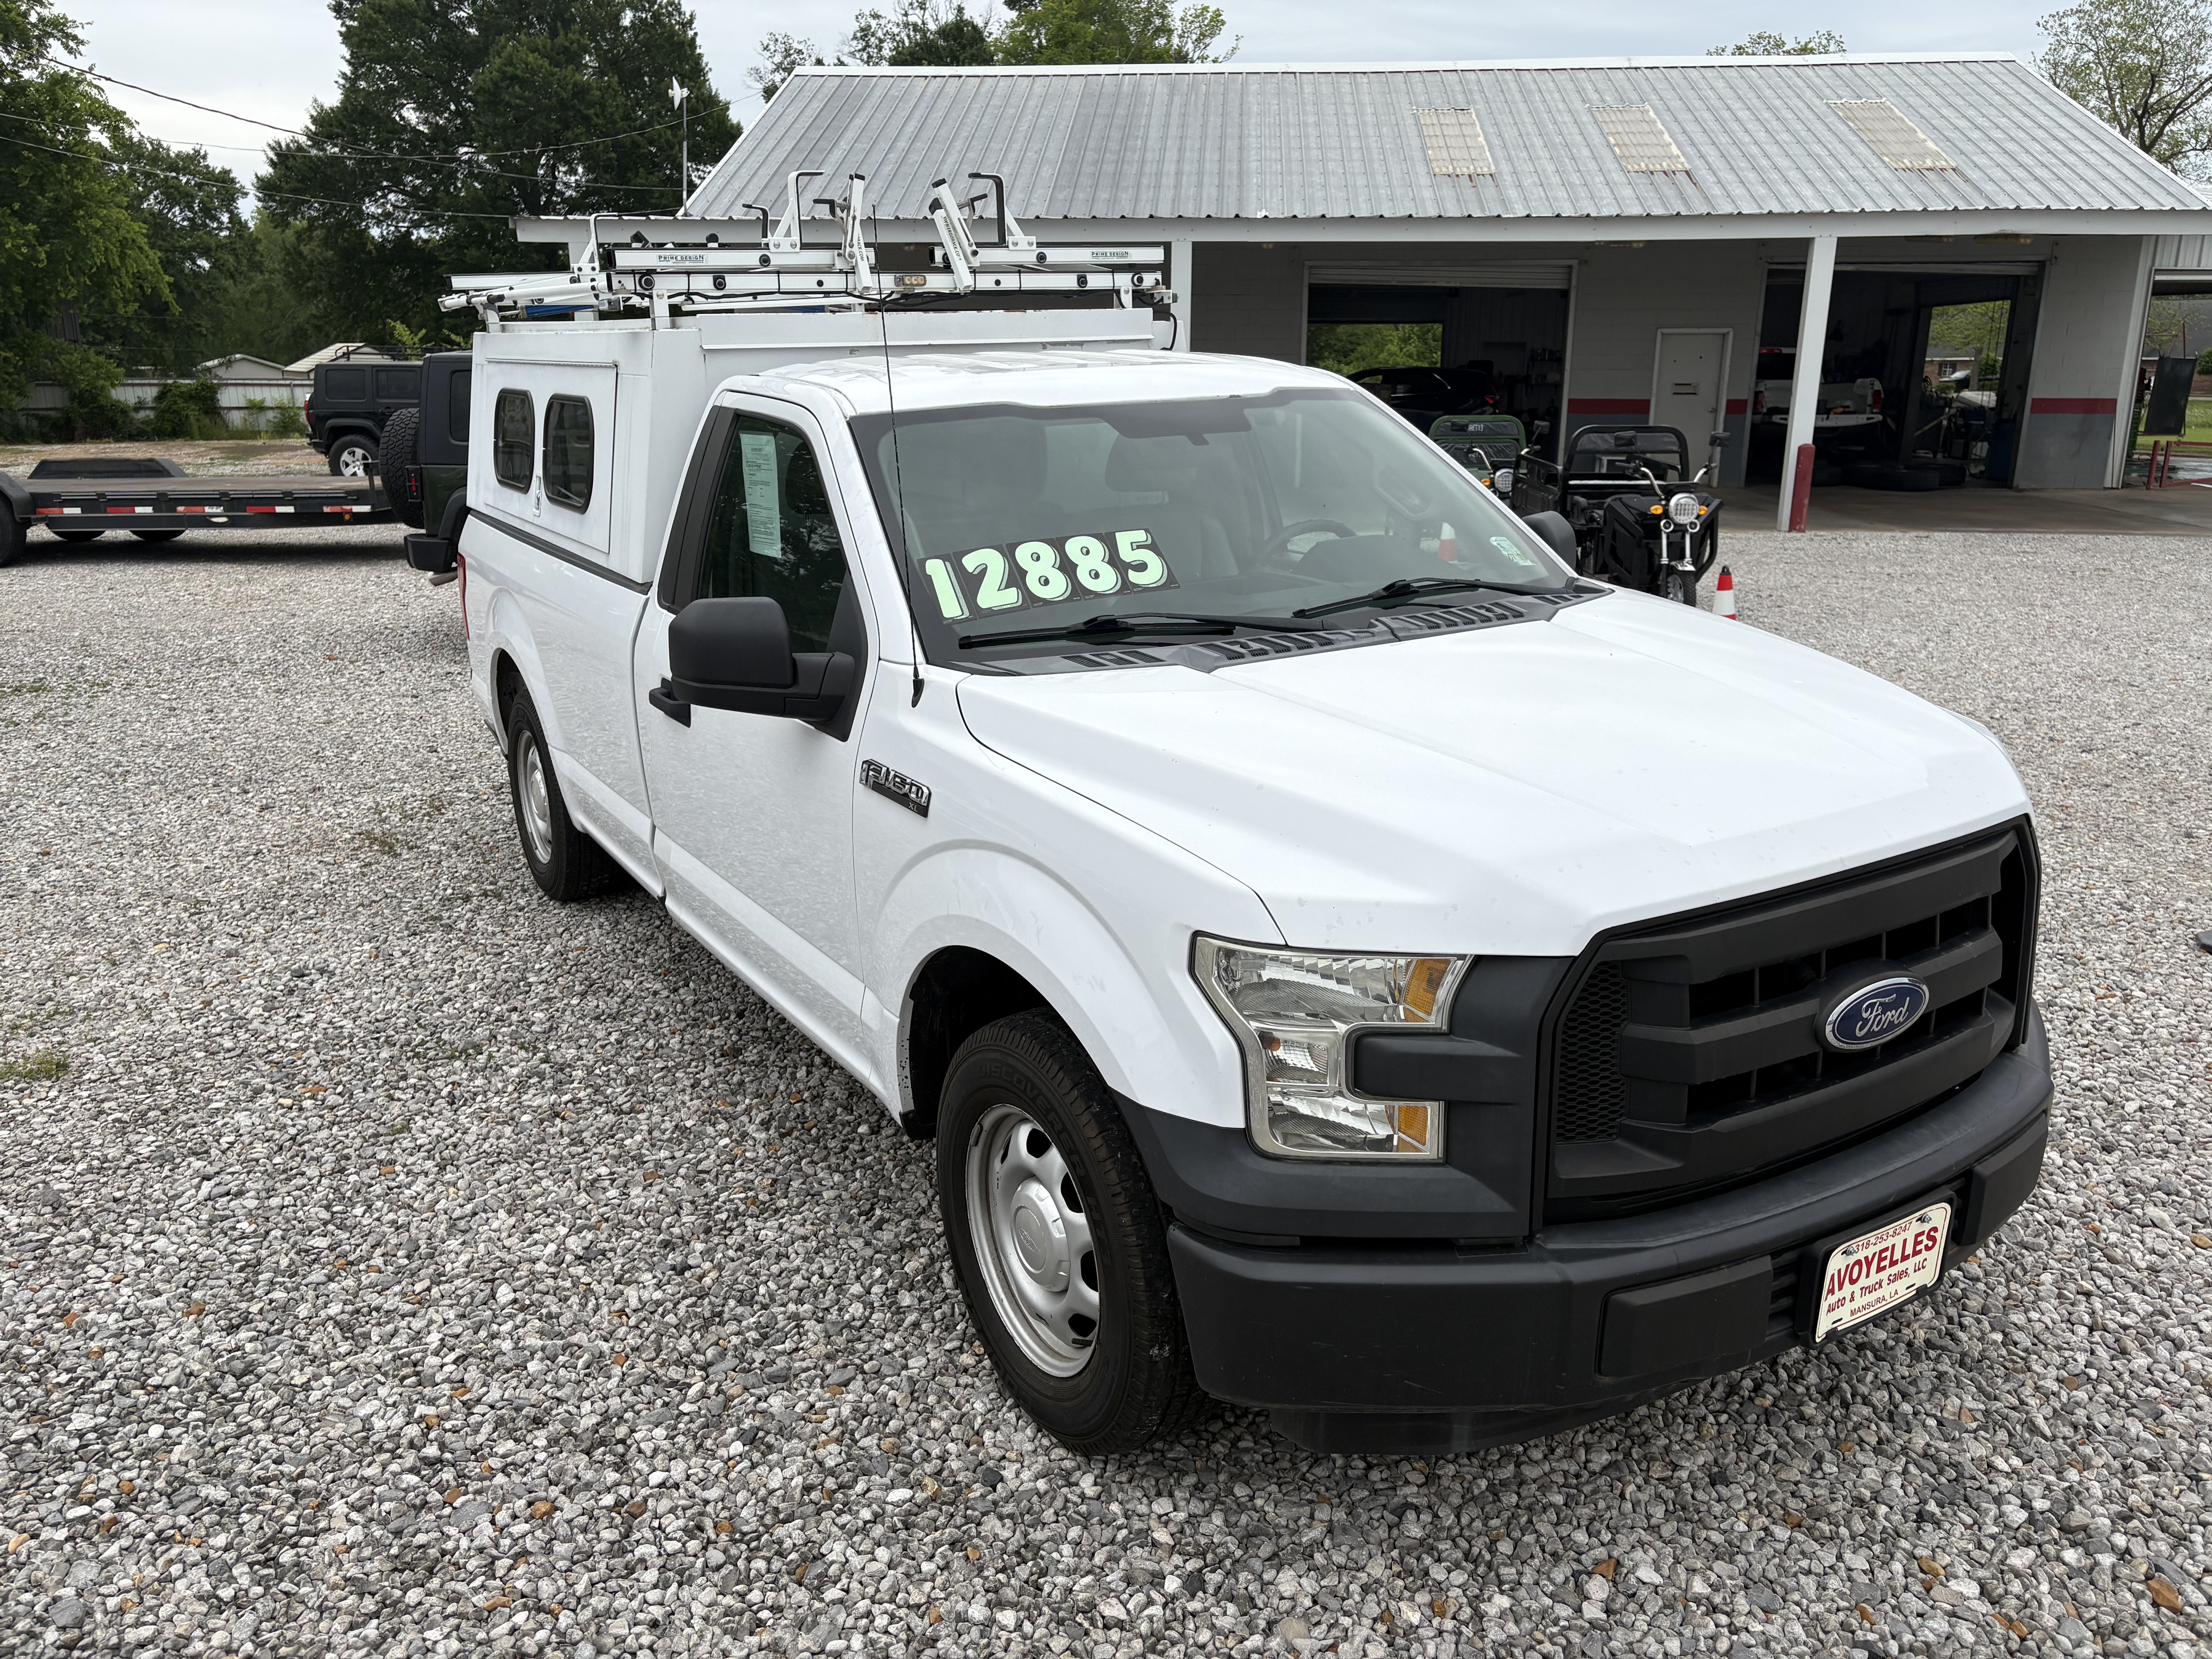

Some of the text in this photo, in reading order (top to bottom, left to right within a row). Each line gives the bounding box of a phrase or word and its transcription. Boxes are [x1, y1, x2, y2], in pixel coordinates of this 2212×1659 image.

[925, 529, 1167, 620] 12885
[908, 802, 918, 812] XL
[1855, 993, 1910, 1037] Ford
[977, 1061, 1085, 1176] DISCOVERER
[1855, 1221, 1913, 1254] 318-253-8247
[1824, 1226, 1939, 1302] AVOYELLES
[1826, 1257, 1927, 1316] Auto & Truck Sales, LLC
[1850, 1289, 1898, 1317] MANSURA, LA
